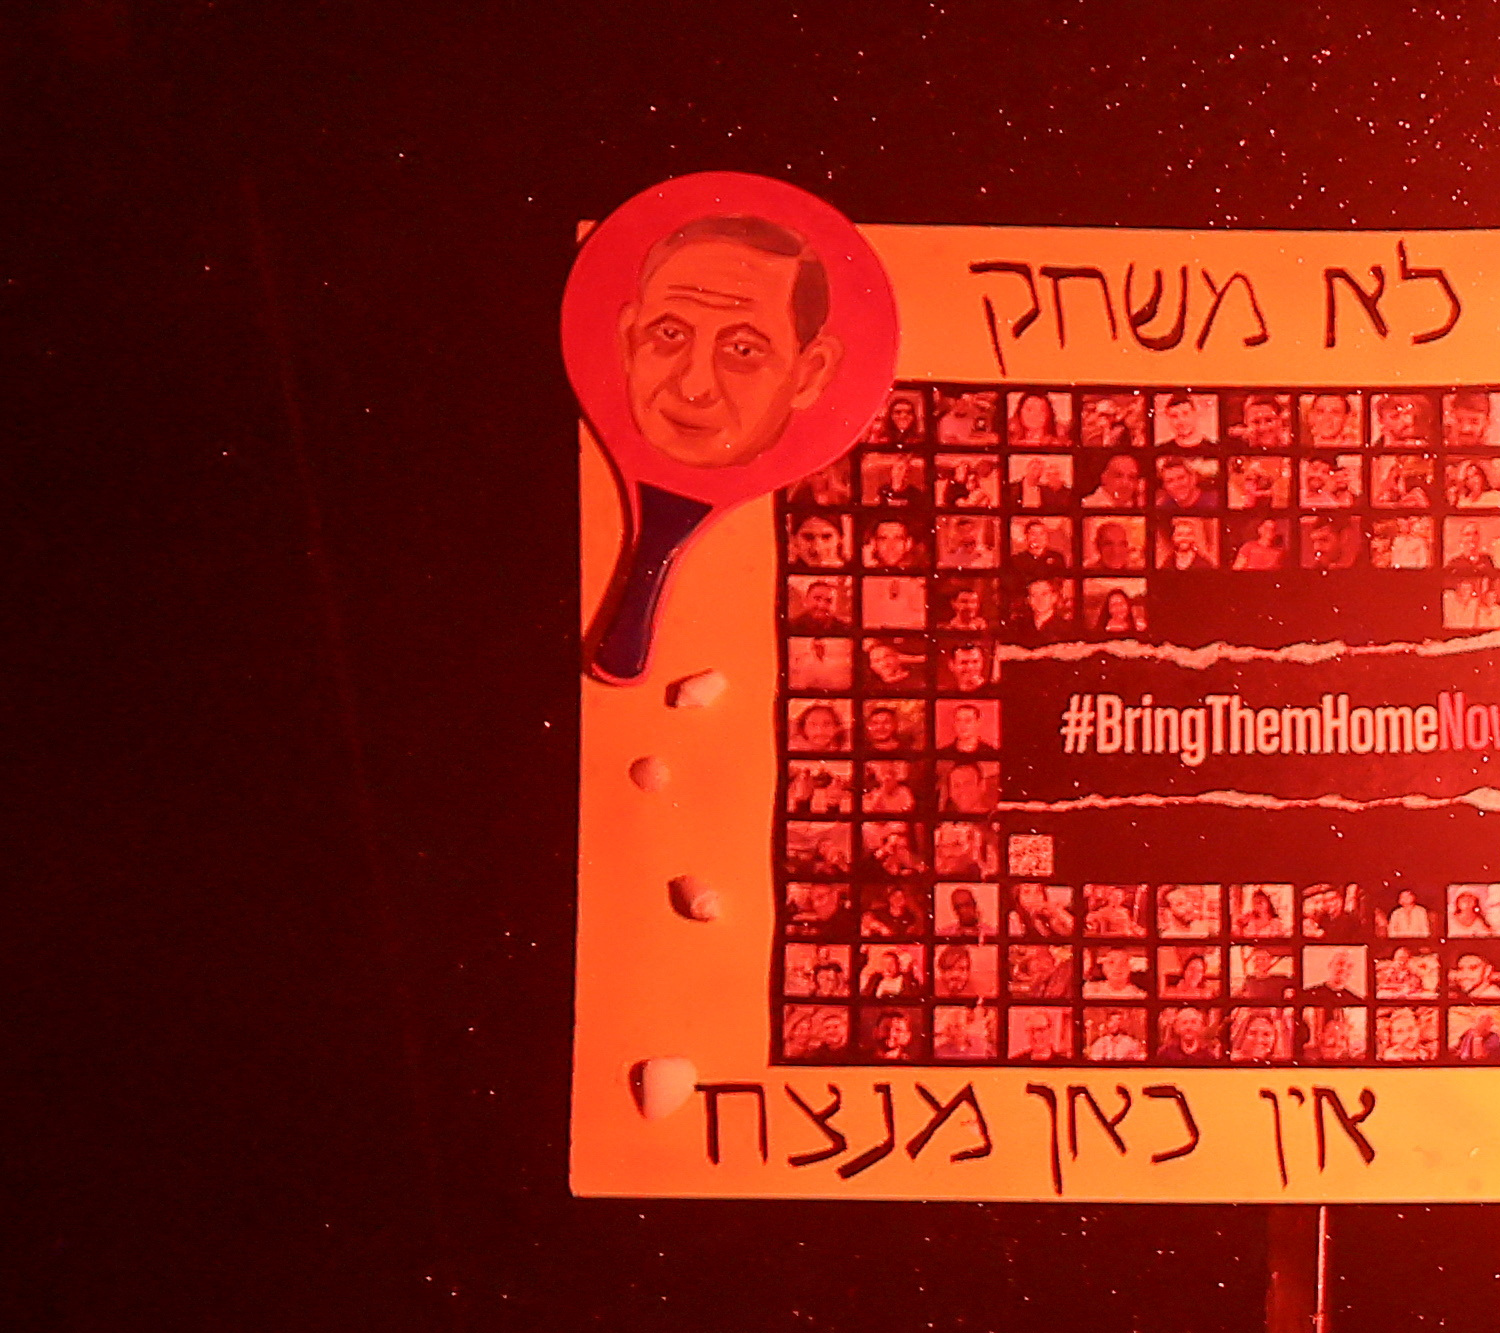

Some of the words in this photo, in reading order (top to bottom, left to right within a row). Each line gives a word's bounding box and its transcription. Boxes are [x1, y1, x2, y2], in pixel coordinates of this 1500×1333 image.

[968, 257, 1270, 378] משחק
[1322, 241, 1463, 346] לא
[693, 1080, 998, 1179] מנצח
[1025, 1081, 1202, 1191] כאן
[1259, 1083, 1378, 1186] אין
